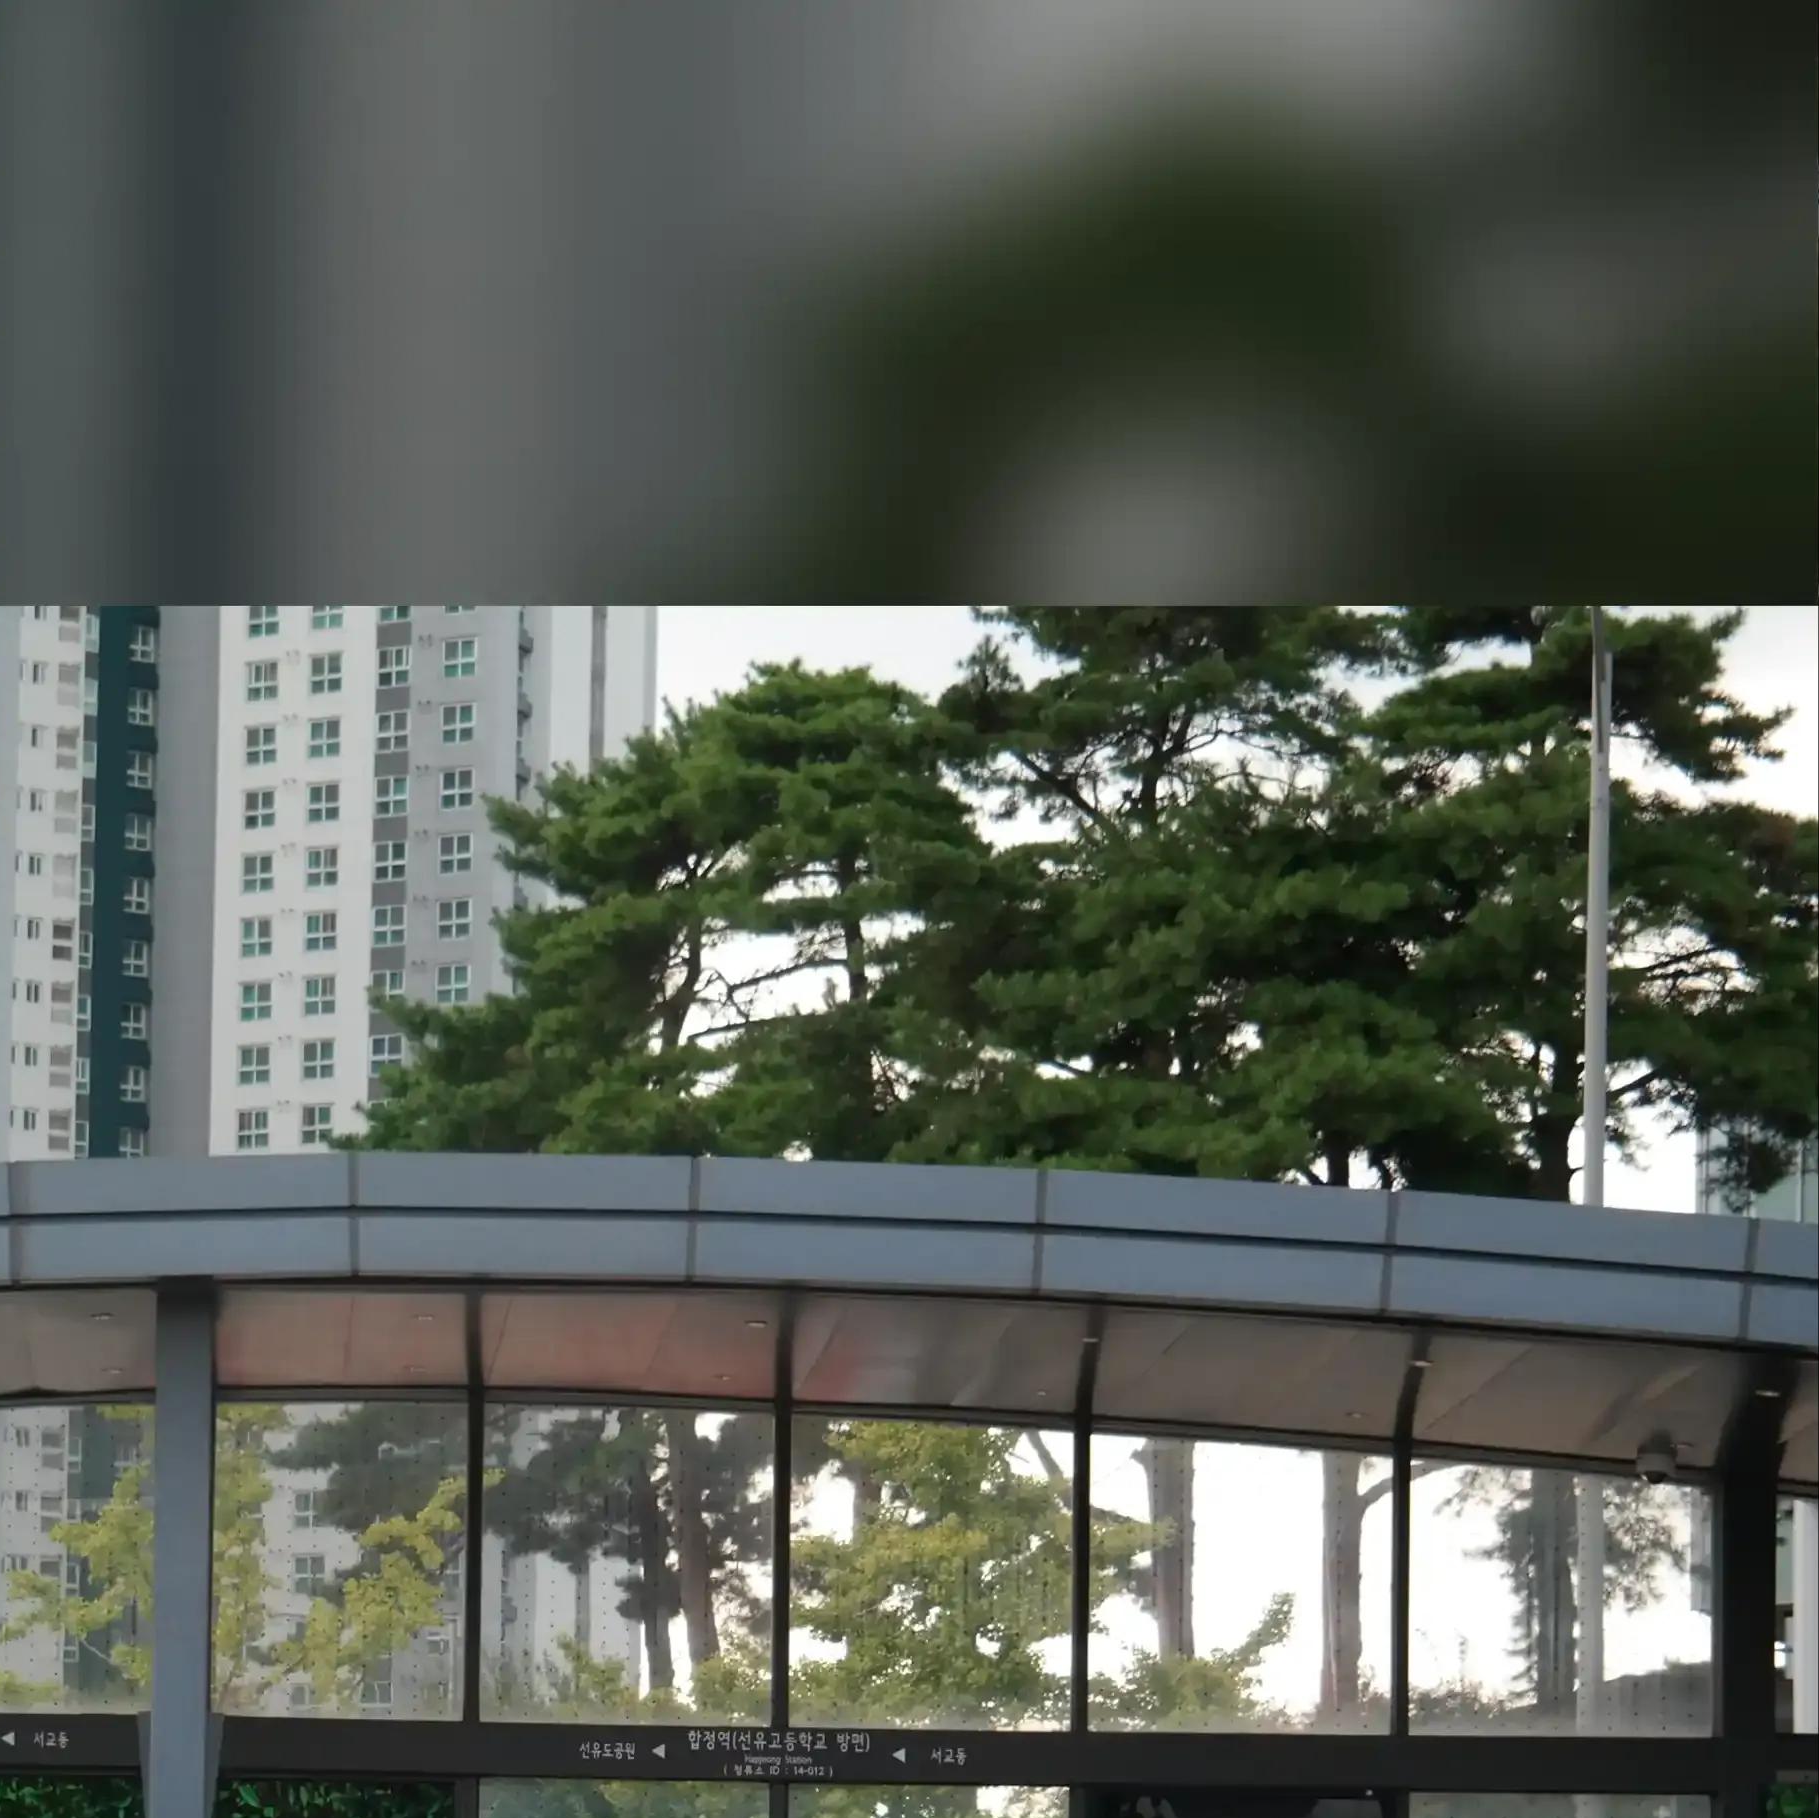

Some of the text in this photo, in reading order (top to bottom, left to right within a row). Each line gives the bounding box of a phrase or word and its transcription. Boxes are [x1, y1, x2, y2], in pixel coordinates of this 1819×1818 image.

[33, 1732, 70, 1749] 서교동
[688, 1730, 871, 1752] 합정역(선유고등학교 방면)
[579, 1741, 636, 1760] 선유도공원
[930, 1747, 967, 1765] 서교동
